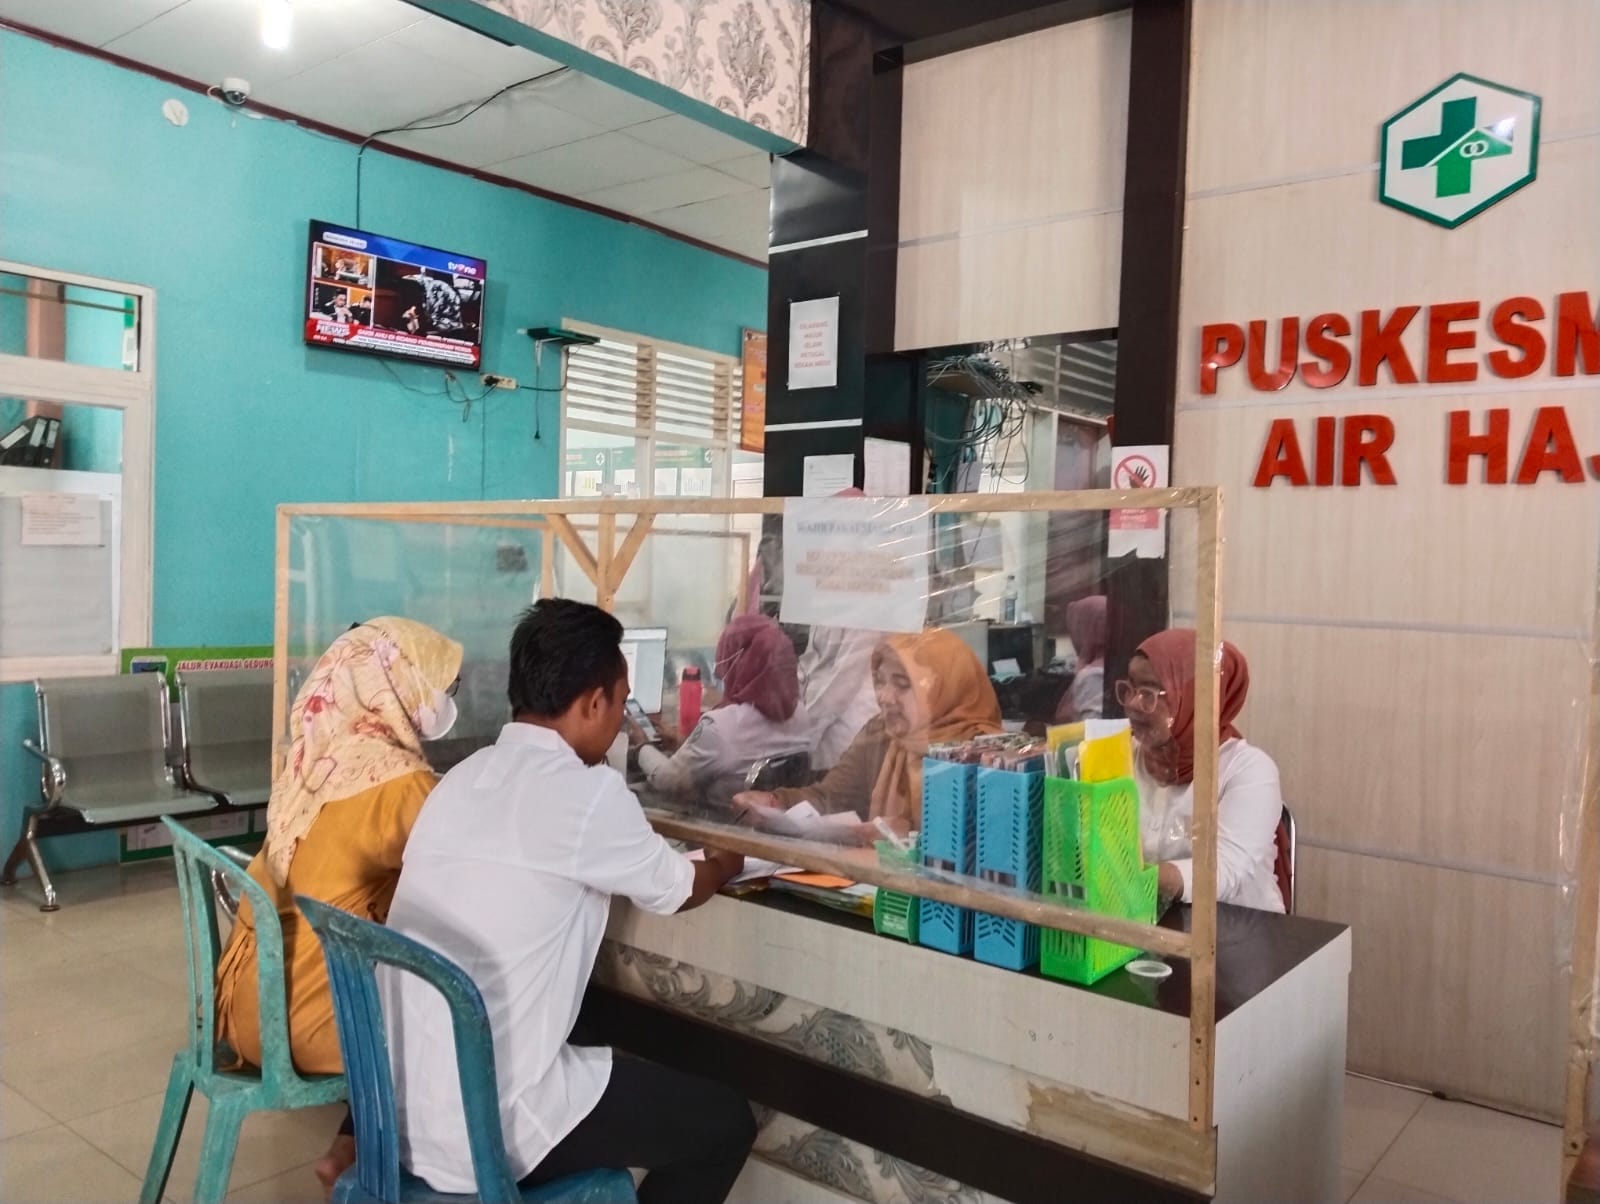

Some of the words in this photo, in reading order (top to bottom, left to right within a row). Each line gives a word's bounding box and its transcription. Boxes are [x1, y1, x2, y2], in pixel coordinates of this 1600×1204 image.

[1199, 291, 1600, 394] PUSKESM
[1253, 413, 1397, 487] AIR
[1445, 406, 1600, 485] HA
[177, 661, 202, 671] JALUR
[204, 660, 242, 670] EVAKUASI
